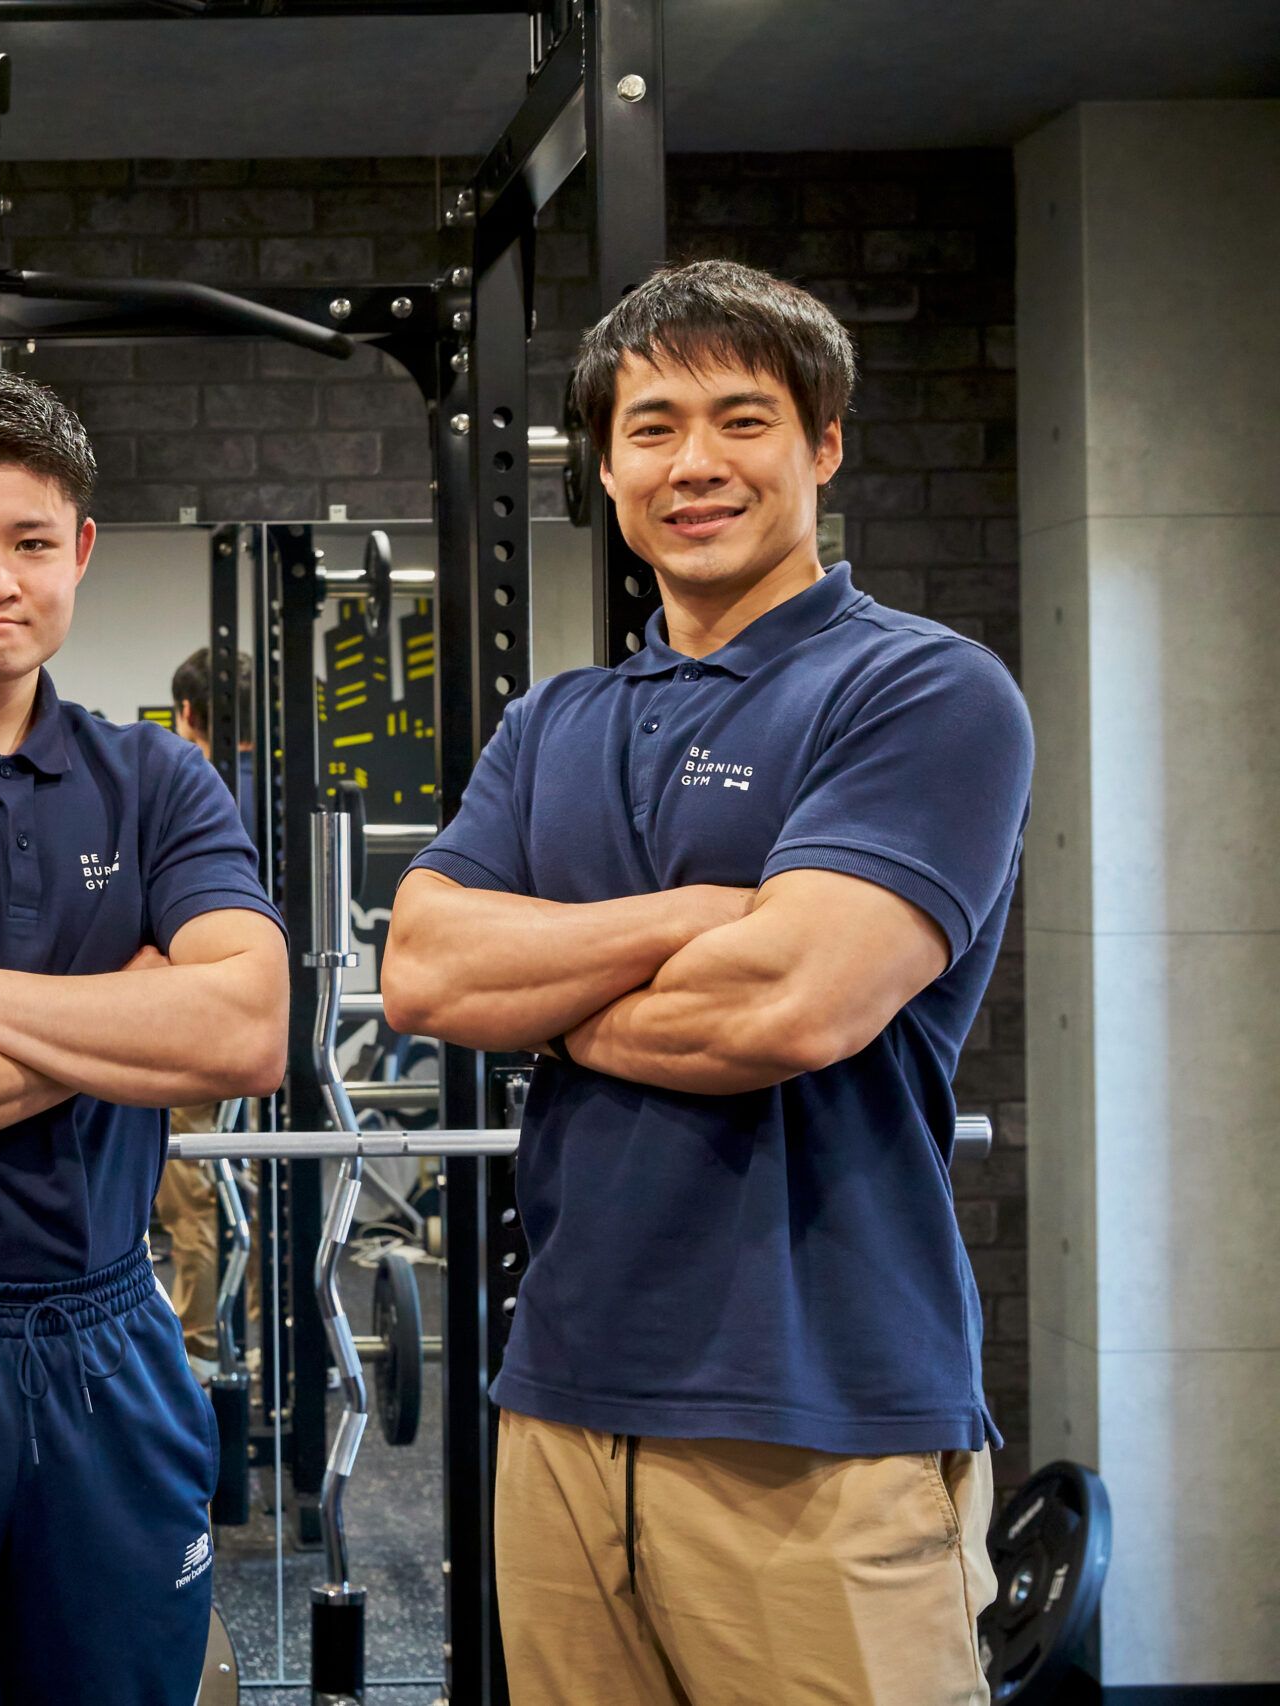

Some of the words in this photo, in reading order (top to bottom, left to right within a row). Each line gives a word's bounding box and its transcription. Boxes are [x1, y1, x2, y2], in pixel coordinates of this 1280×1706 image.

[689, 746, 711, 760] BE
[685, 760, 753, 777] BURNING
[681, 775, 711, 786] GYM
[80, 853, 100, 865] BE
[85, 879, 110, 890] GY
[175, 1572, 192, 1589] new
